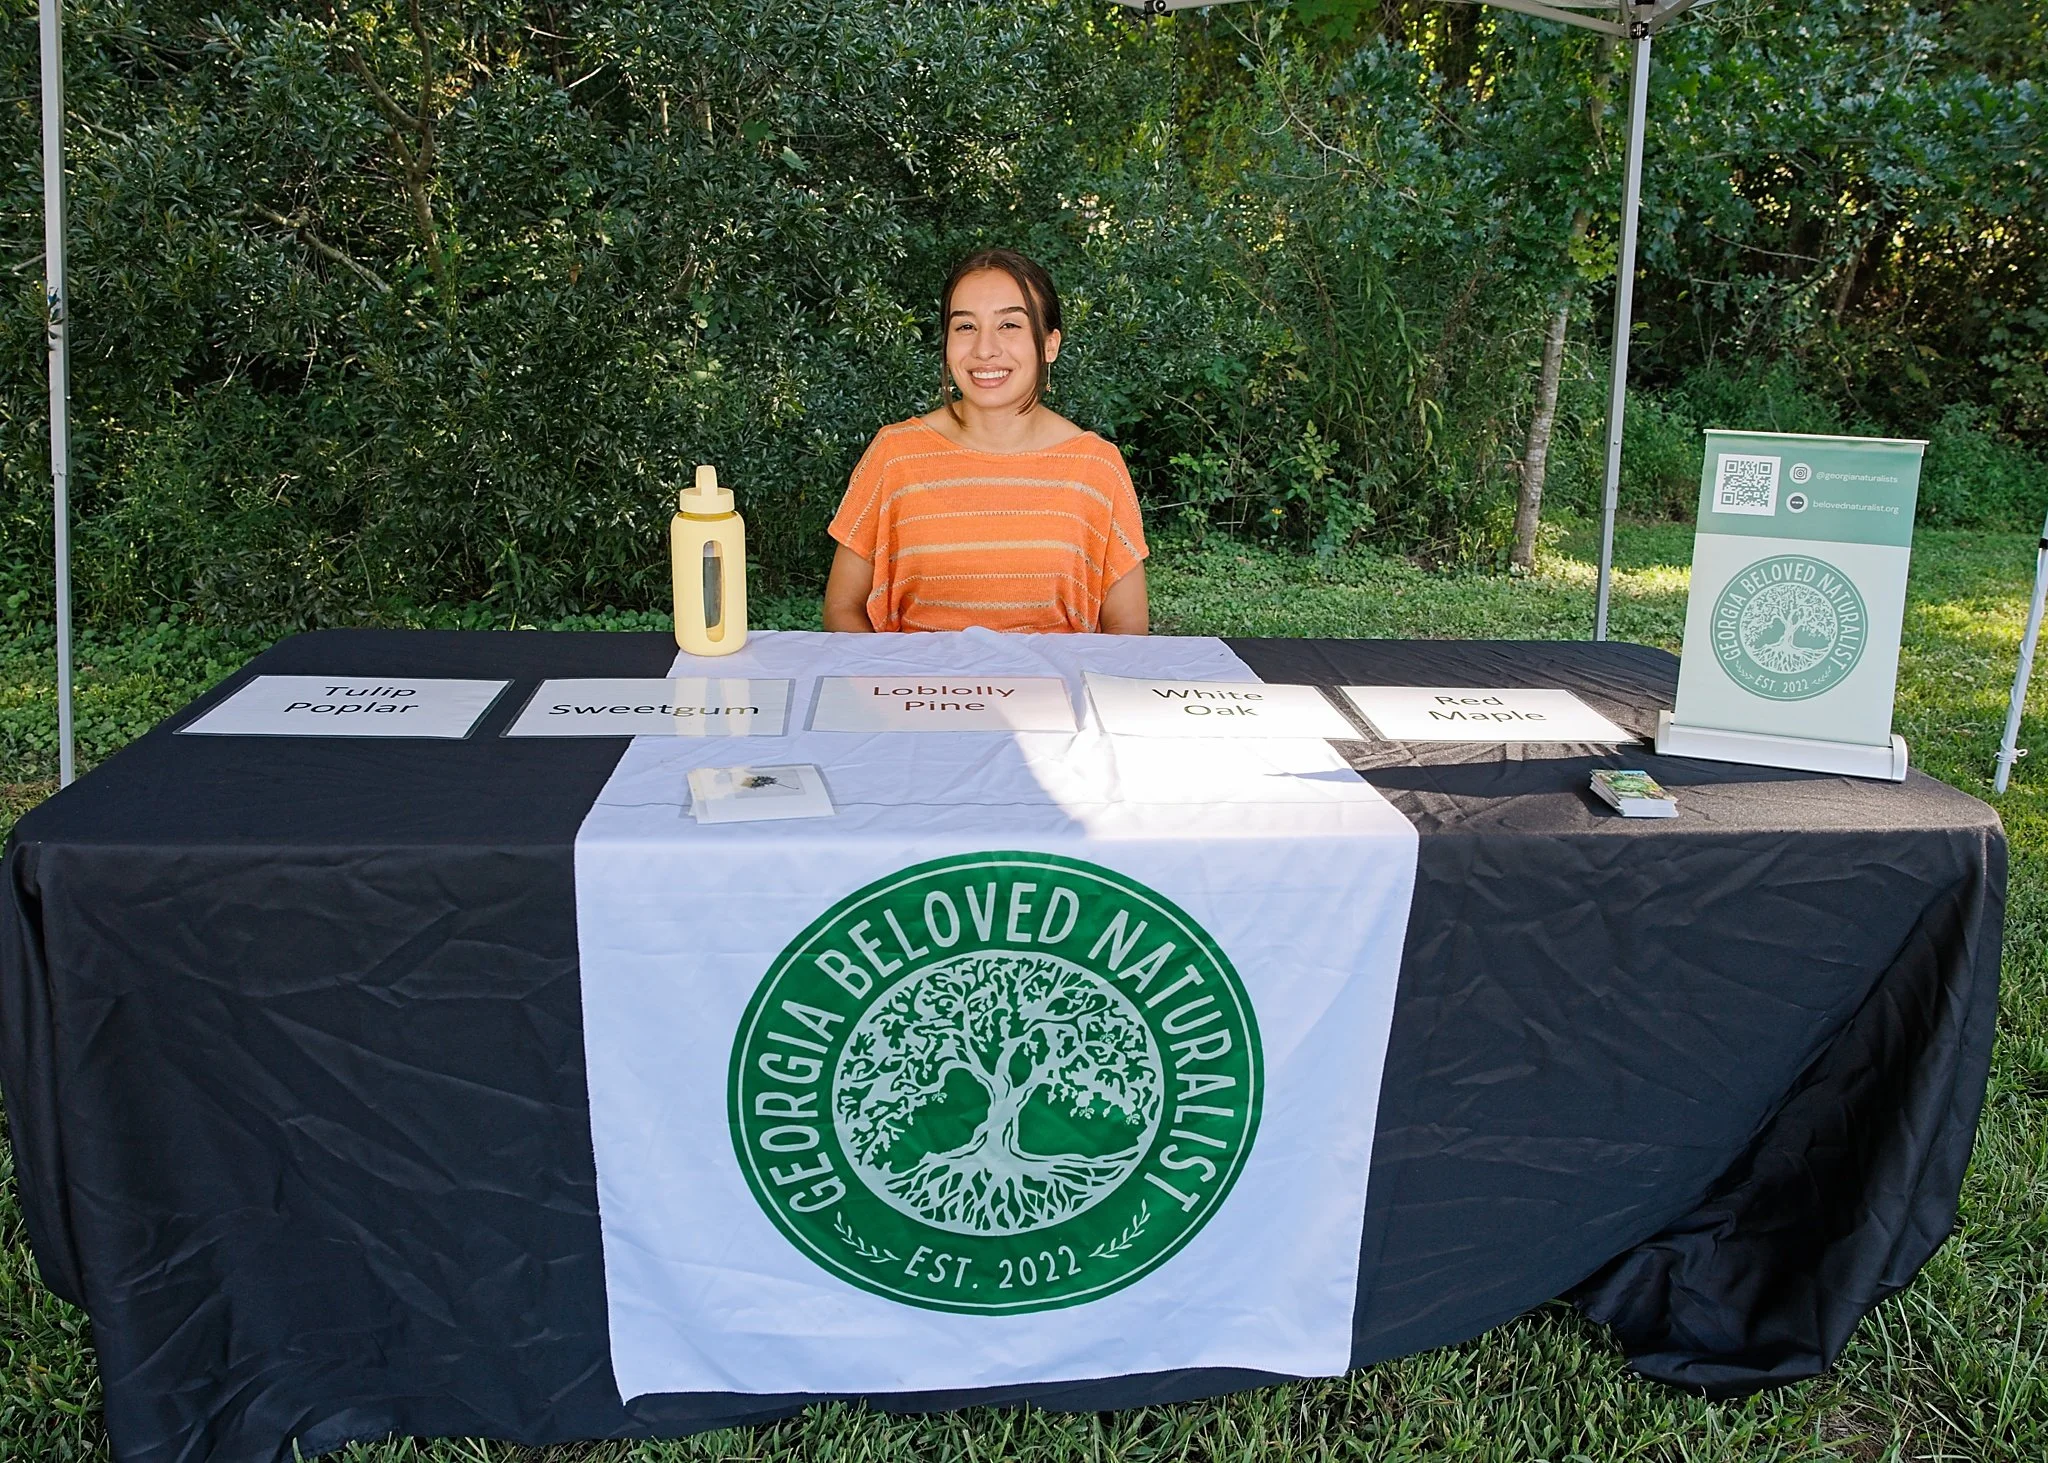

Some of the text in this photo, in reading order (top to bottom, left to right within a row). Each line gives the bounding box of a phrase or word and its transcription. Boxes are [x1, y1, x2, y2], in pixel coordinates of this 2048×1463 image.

[1816, 471, 1898, 483] @georgianaturalists
[1813, 500, 1899, 514] belovednaturalist.org
[1716, 562, 1860, 671] GEORGIA BELOVED NATURALIST
[1754, 675, 1809, 693] EST. 2022
[325, 686, 416, 698] Tulip
[874, 686, 1015, 697] Loblolly
[1152, 688, 1264, 701] White
[905, 701, 985, 711] Pine
[1434, 696, 1504, 706] Red
[284, 702, 419, 715] Poplar
[549, 704, 759, 717] Sweetgum
[1184, 705, 1258, 716] Oak
[1428, 710, 1547, 723] Maple
[755, 881, 1236, 1214] GEORGIA BELOVED NATURALIST
[904, 1244, 1081, 1289] EST. 2022
